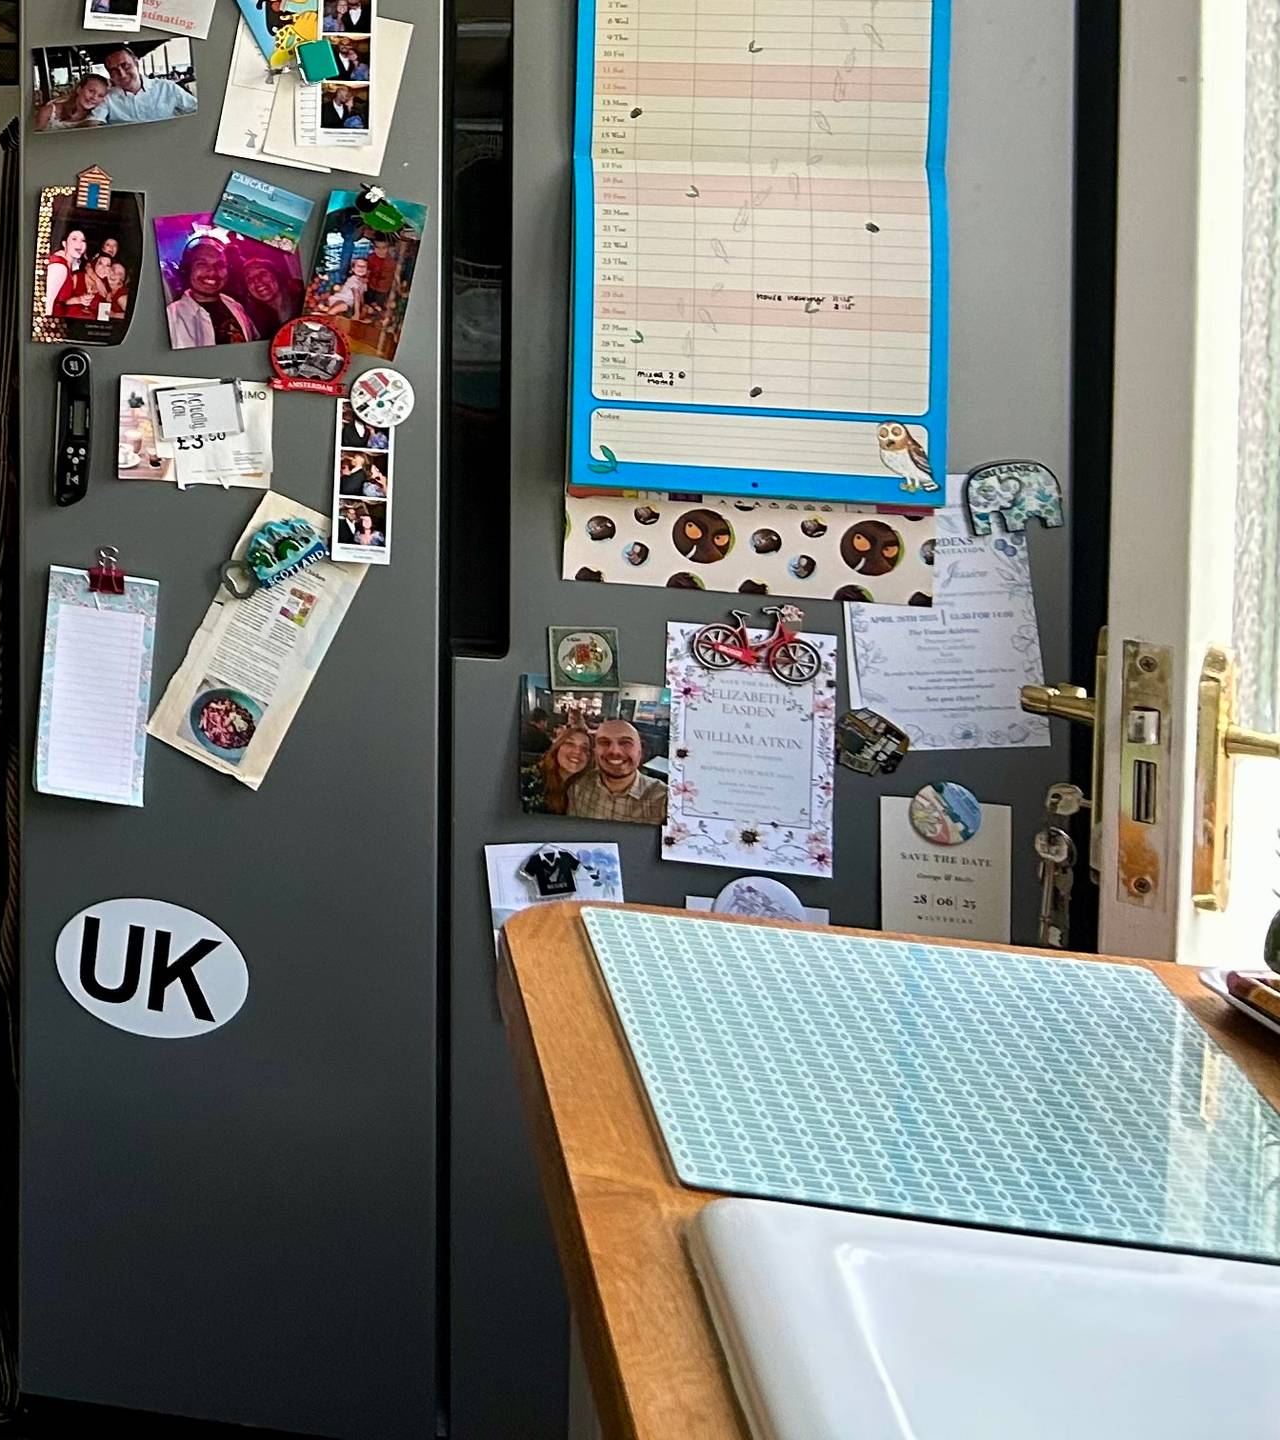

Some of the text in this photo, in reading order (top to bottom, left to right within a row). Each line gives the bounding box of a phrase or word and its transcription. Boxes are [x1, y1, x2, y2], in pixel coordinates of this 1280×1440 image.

[287, 381, 333, 392] AMSTERDAM
[596, 411, 620, 420] Notes
[996, 464, 1040, 475] LANKA
[267, 550, 324, 586] SCOTLAND
[713, 688, 788, 705] ELIZABETH
[722, 702, 776, 718] EASDEN
[693, 729, 803, 750] WILLIAM ATKIN
[900, 851, 993, 868] SAVE THE DATE
[913, 893, 928, 905] 28
[936, 896, 953, 907] 06
[80, 915, 223, 1023] UK
